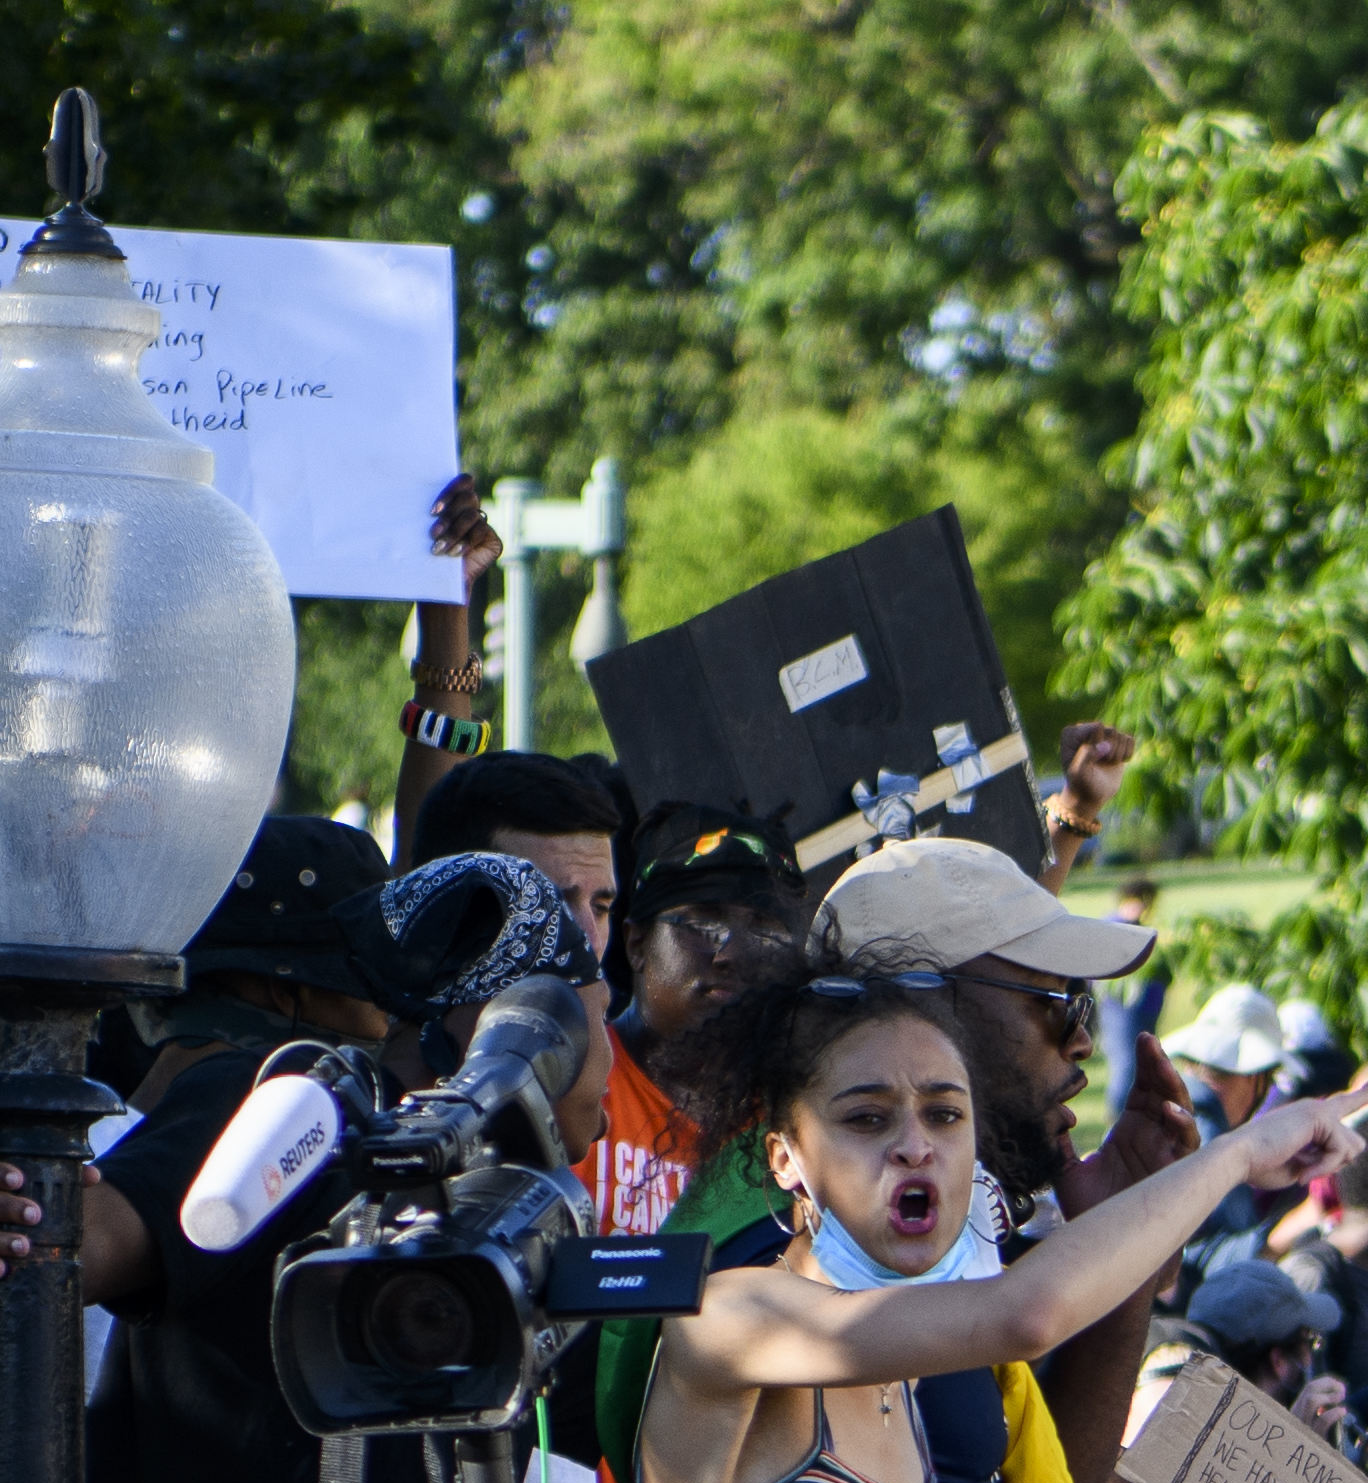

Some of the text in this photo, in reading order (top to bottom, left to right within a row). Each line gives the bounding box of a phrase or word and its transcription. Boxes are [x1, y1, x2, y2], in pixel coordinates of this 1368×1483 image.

[278, 1121, 326, 1180] REUTERS
[591, 1247, 663, 1260] Panasonic
[1213, 1431, 1247, 1472] WE
[1229, 1400, 1284, 1457] OUR
